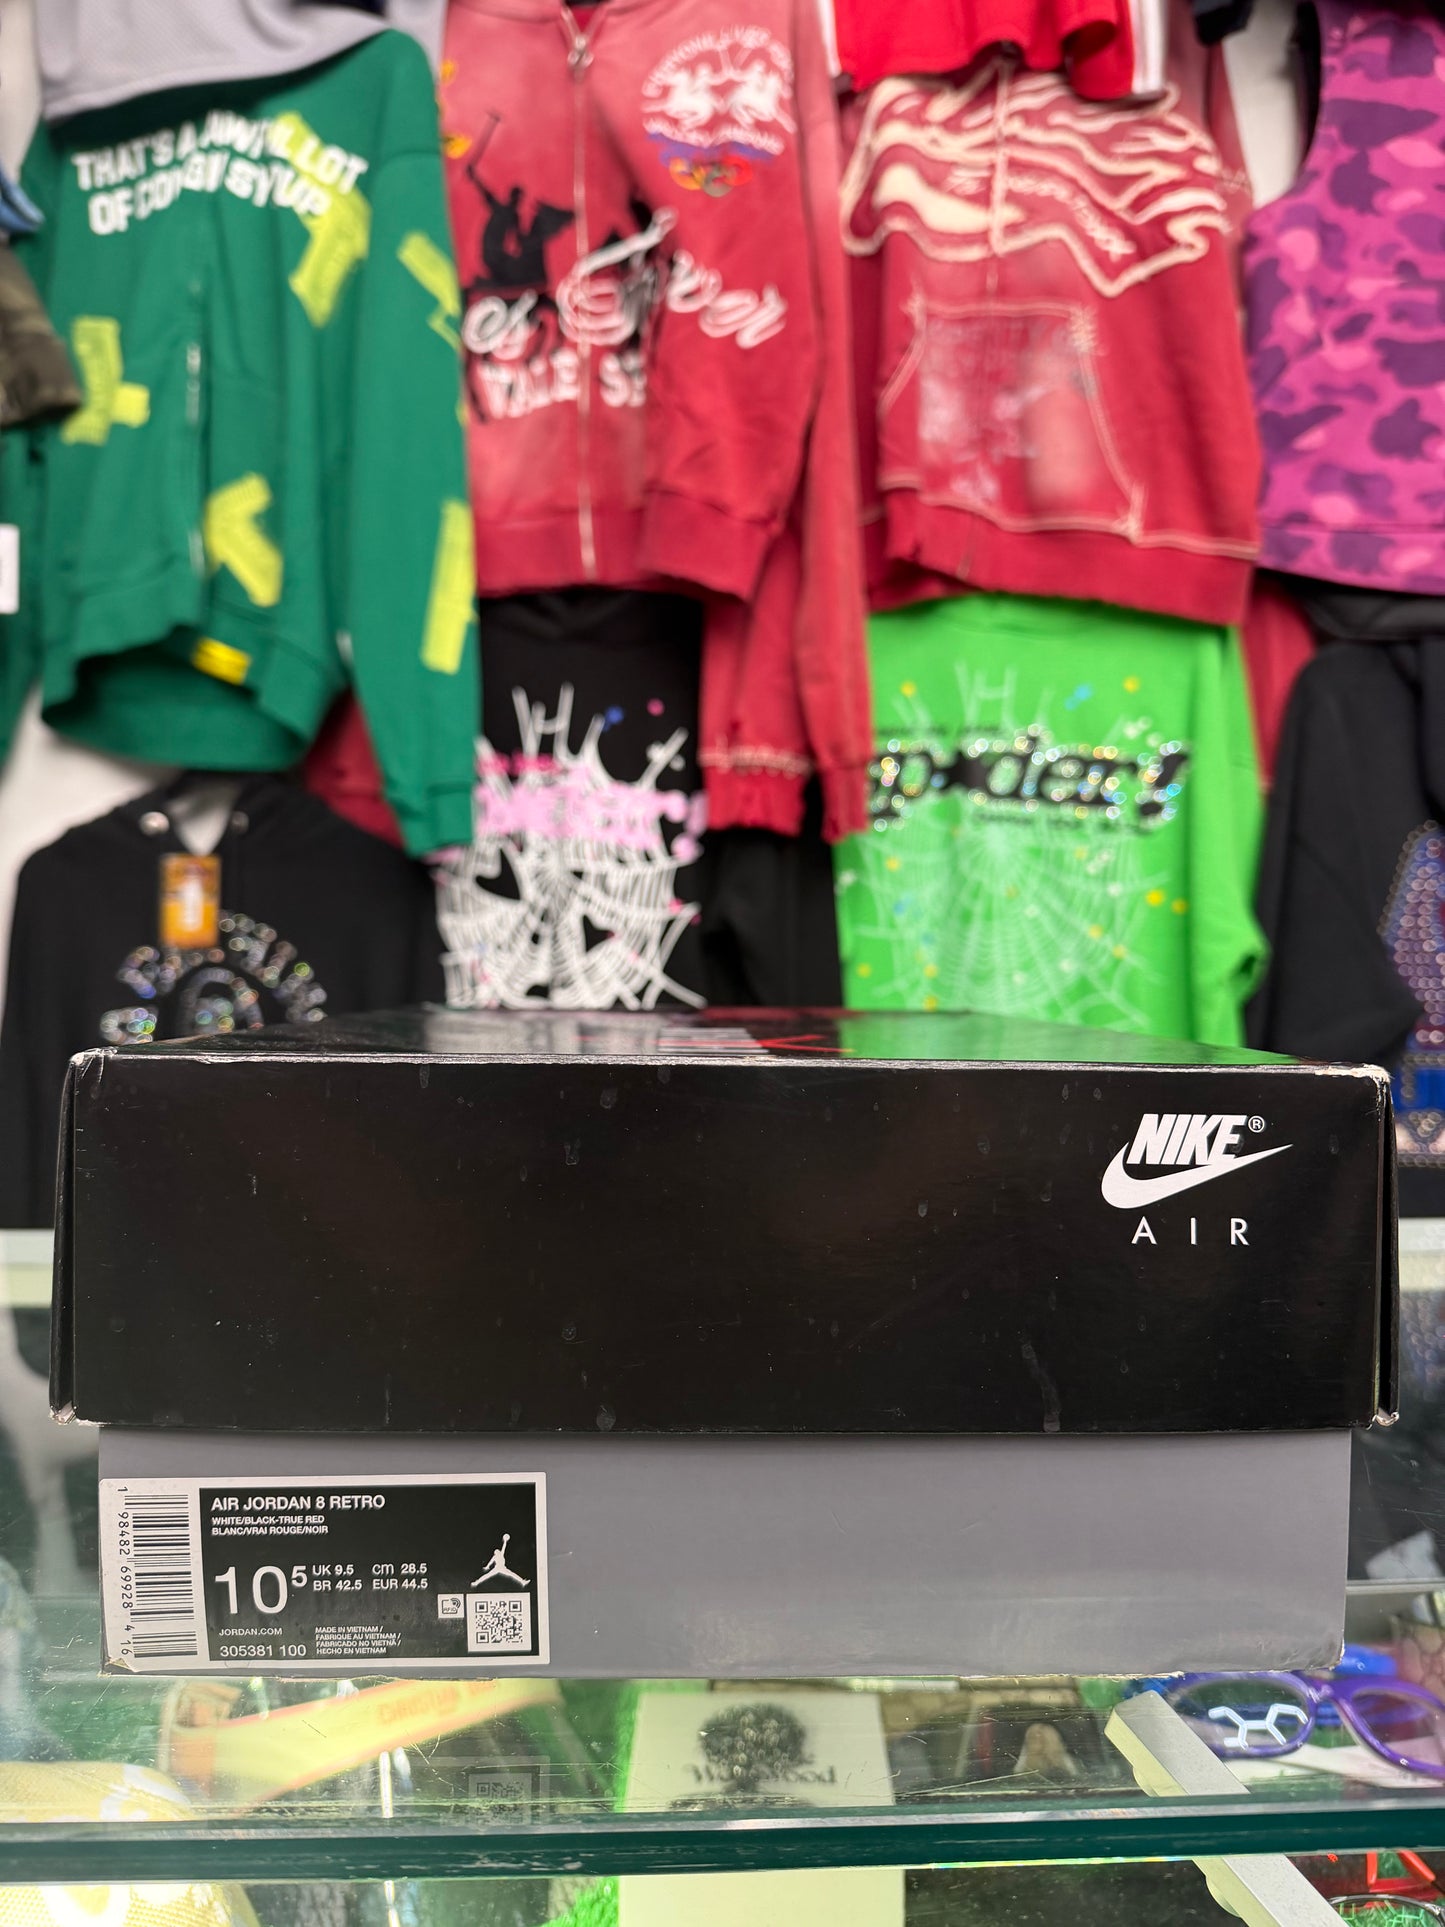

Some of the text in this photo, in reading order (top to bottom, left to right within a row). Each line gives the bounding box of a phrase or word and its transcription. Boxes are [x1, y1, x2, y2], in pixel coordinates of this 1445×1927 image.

[294, 136, 369, 195] LOT
[87, 186, 134, 236] OF
[1131, 1216, 1250, 1246] AIR
[211, 1494, 386, 1511] AIR JORDAN 8 RETRO
[211, 1515, 325, 1525] WHITE/BLACK-TRUE RED
[117, 1511, 131, 1556] 98482
[211, 1525, 329, 1536] BLANC/VRAI ROUGE/NOIR
[311, 1564, 331, 1576] UK
[334, 1564, 354, 1576] 9.5
[400, 1563, 428, 1575] 28.5
[120, 1565, 134, 1609] 69928
[313, 1578, 429, 1592] BR 42.5 EUR 44.5
[219, 1627, 283, 1637] JORDAN.COM
[219, 1644, 307, 1657] 305381 100
[354, 1647, 387, 1655] VIETNAM
